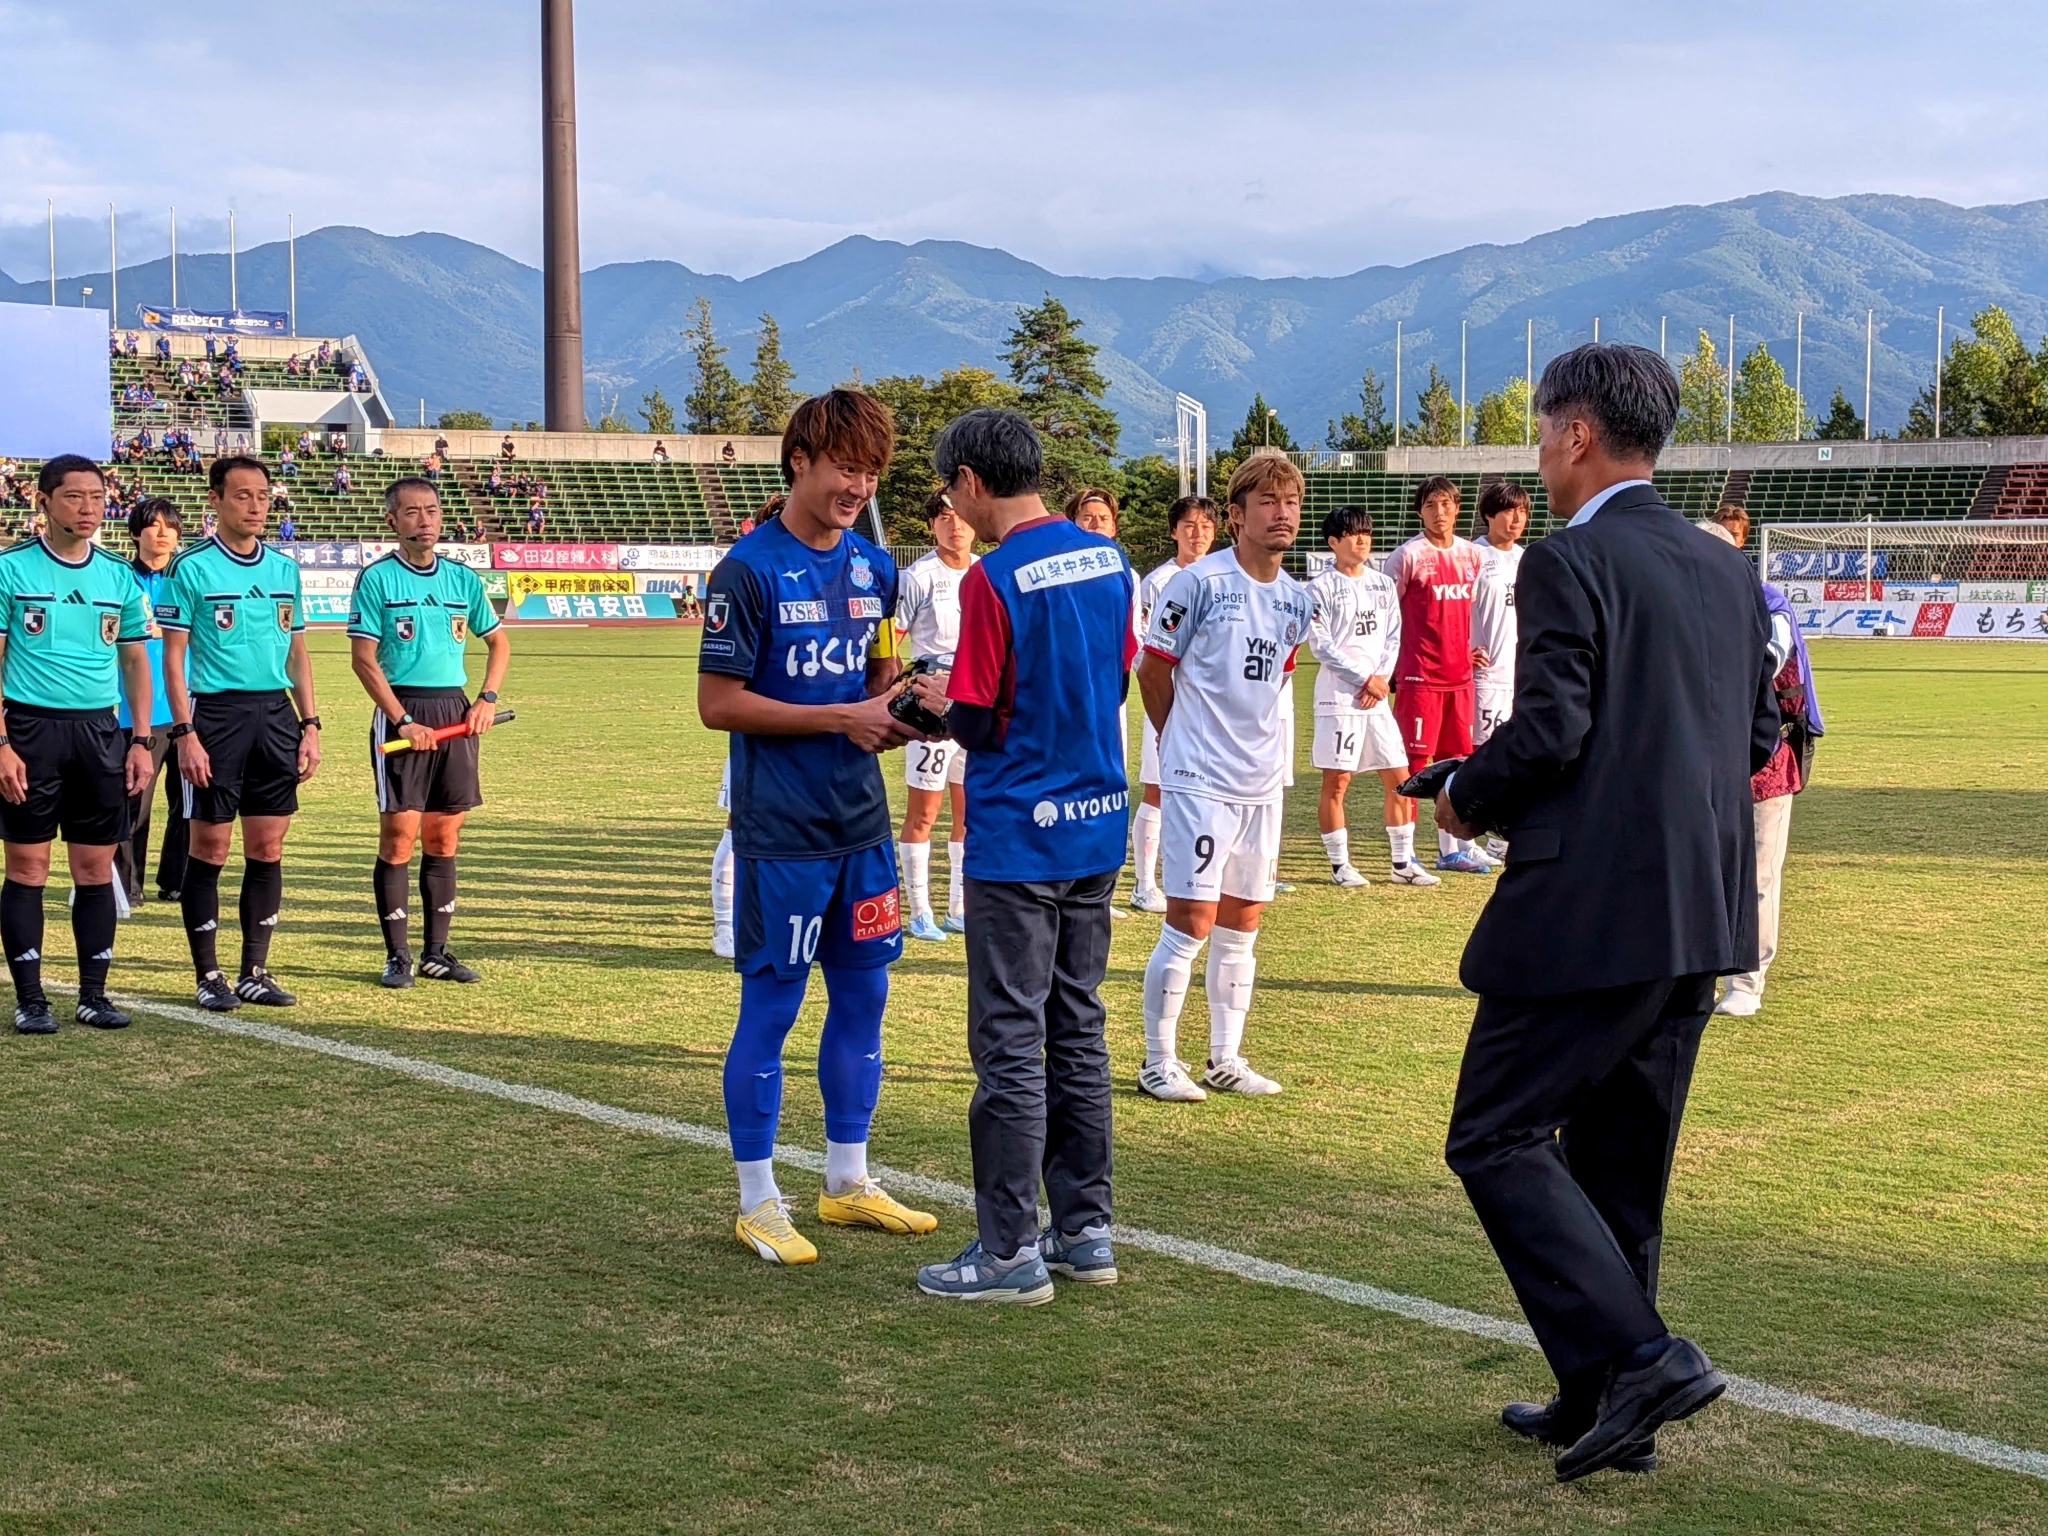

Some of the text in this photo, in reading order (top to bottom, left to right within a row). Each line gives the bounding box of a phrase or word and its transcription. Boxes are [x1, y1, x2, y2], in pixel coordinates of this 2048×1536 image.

[171, 314, 225, 327] RESPECT
[1342, 455, 1351, 464] N
[1820, 449, 1829, 459] N
[524, 550, 617, 564] 田辺産婦人科
[545, 580, 630, 593] 甲府警備保障
[1432, 584, 1471, 600] YKK
[1836, 591, 1872, 599] マンショ
[1969, 589, 2016, 601] 株式会社
[546, 595, 648, 617] 明治安田
[1214, 593, 1247, 604] SHOEI
[1355, 621, 1377, 636] ap
[1799, 609, 1907, 629] エノモト
[1246, 637, 1277, 658] YKK
[1244, 656, 1273, 682] ap
[1415, 717, 1424, 740] 1
[1482, 709, 1503, 731] 56
[1334, 731, 1354, 755] 14
[916, 746, 945, 774] 28
[1194, 834, 1215, 874] 9
[857, 915, 900, 936] MARUAI
[788, 915, 823, 964] 10
[960, 1264, 979, 1284] N
